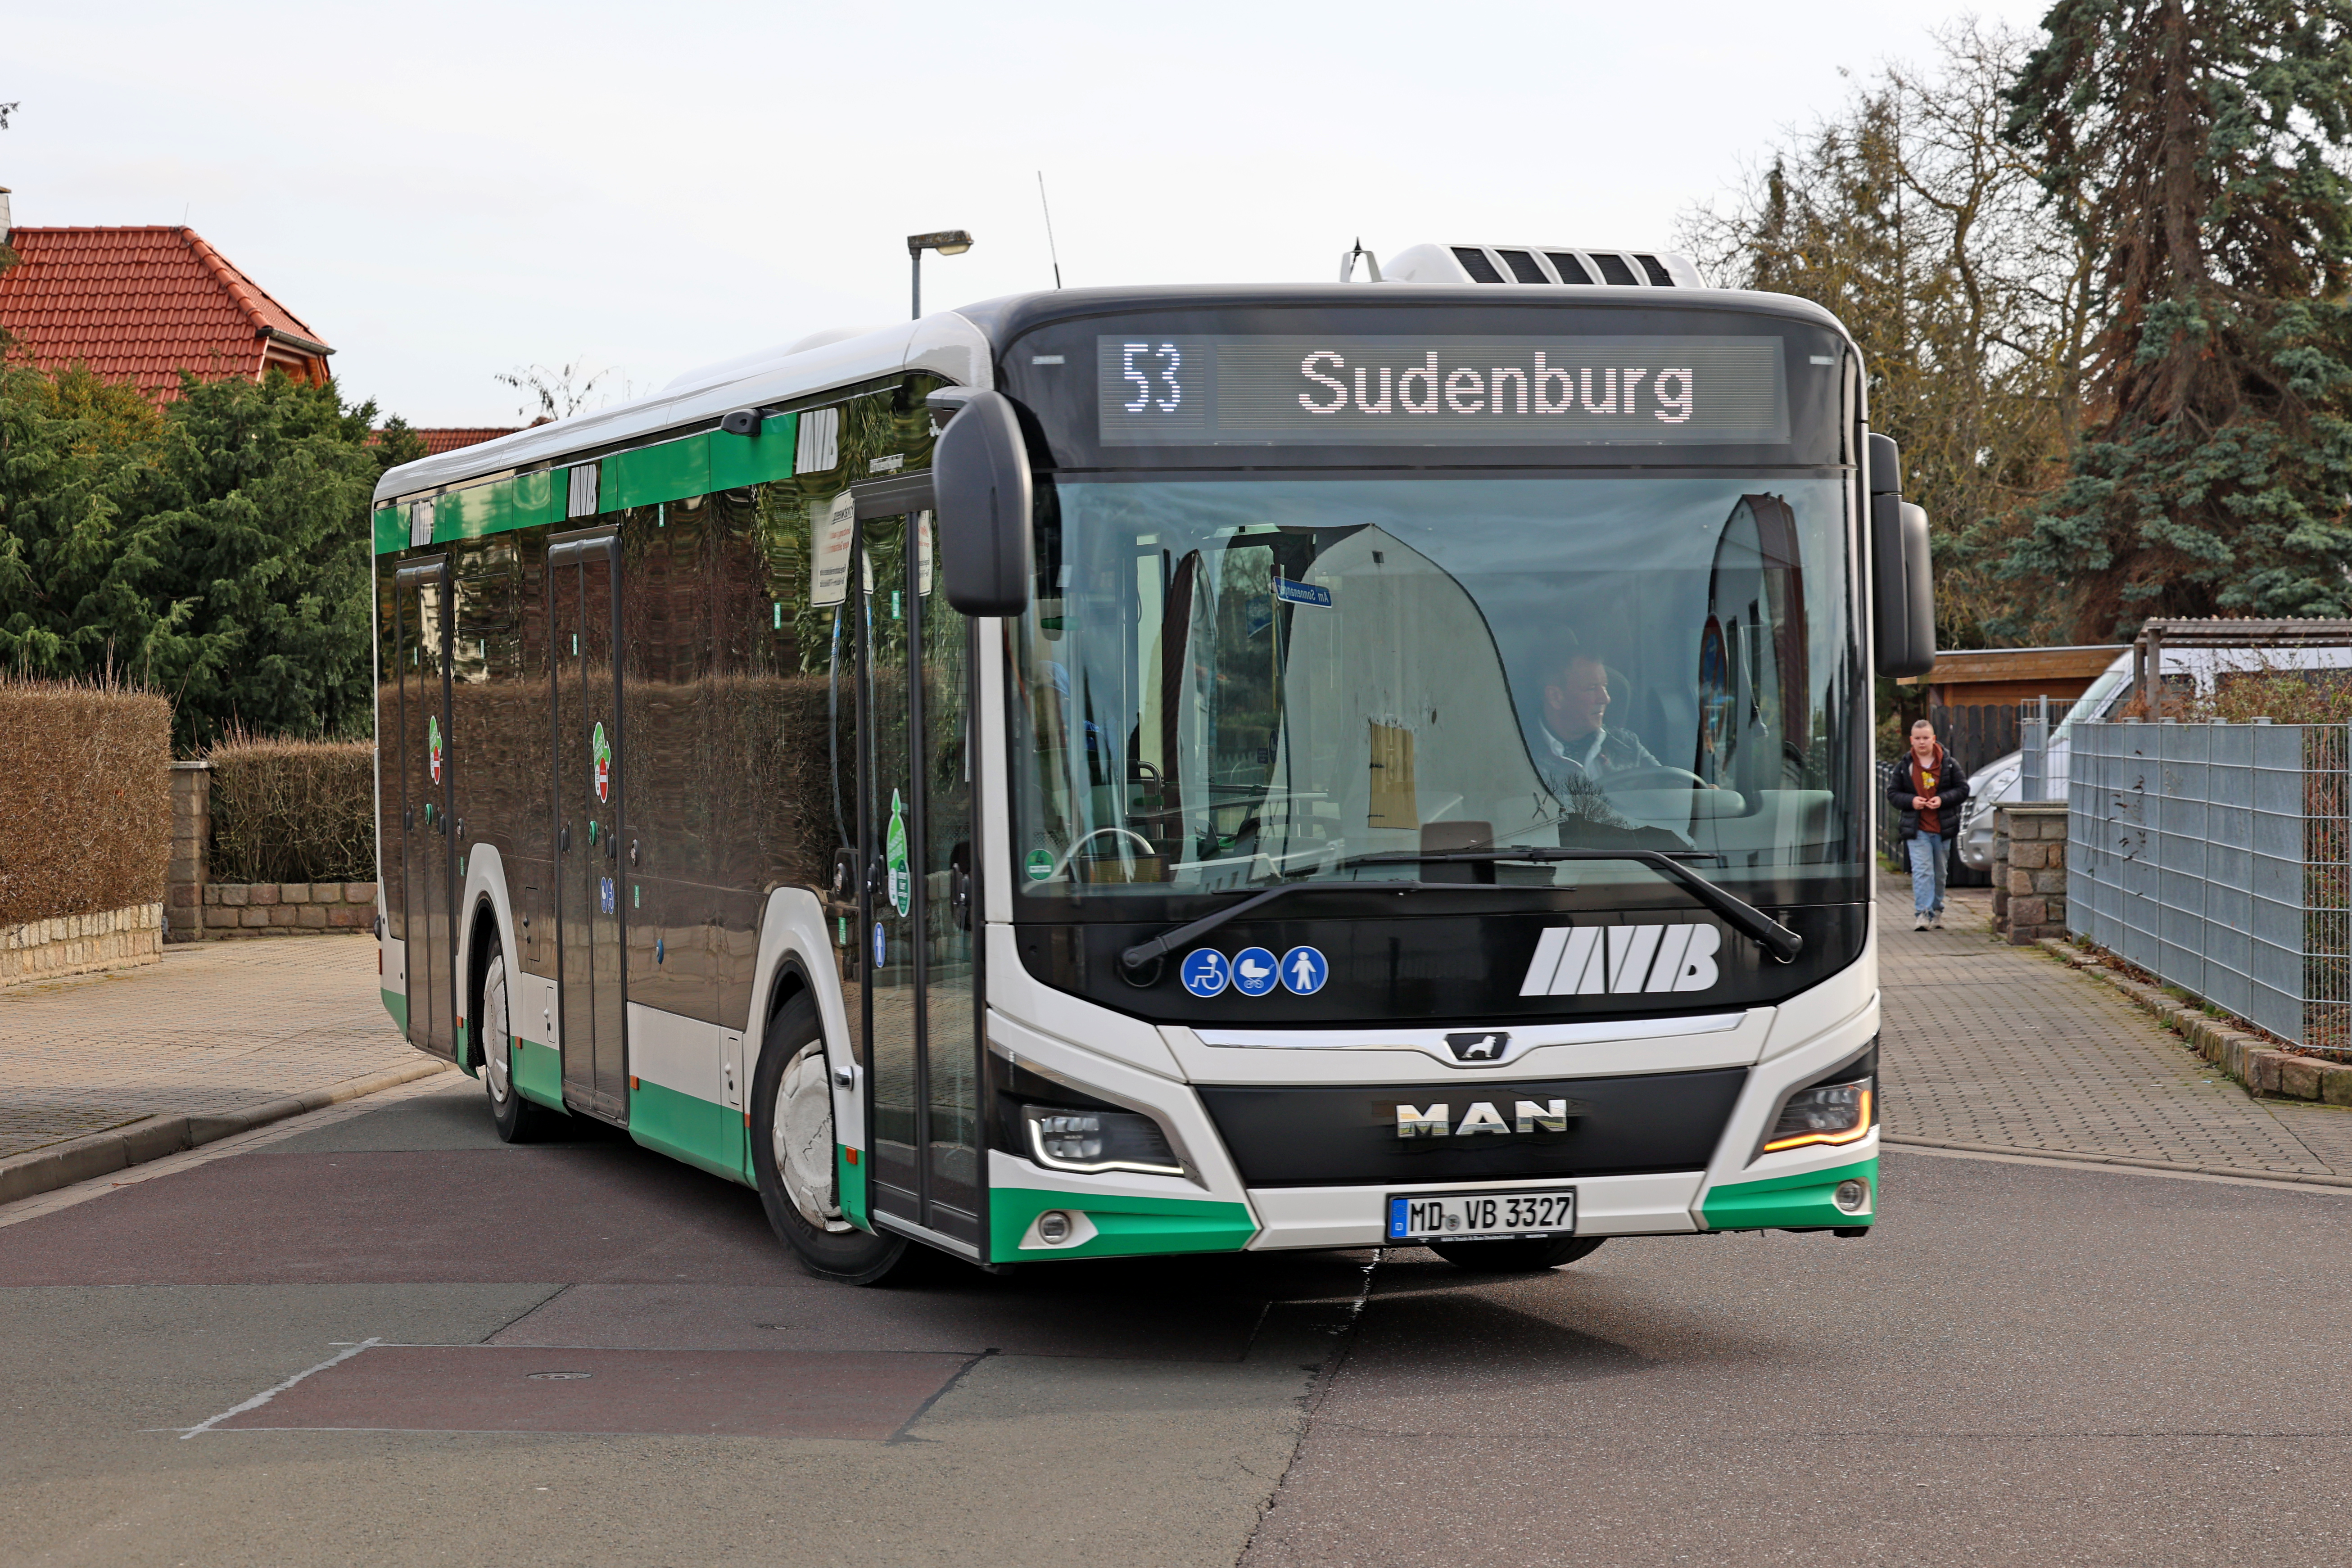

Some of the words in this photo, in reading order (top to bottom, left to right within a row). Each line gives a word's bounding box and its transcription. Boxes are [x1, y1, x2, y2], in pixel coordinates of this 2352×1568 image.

[1123, 343, 1181, 413] 53
[1298, 351, 1694, 425] Sudenburg
[1395, 1098, 1568, 1138] MAN
[1396, 1223, 1404, 1231] D
[1410, 1202, 1443, 1232] MD
[1465, 1199, 1497, 1229] VB
[1506, 1196, 1570, 1228] 3327
